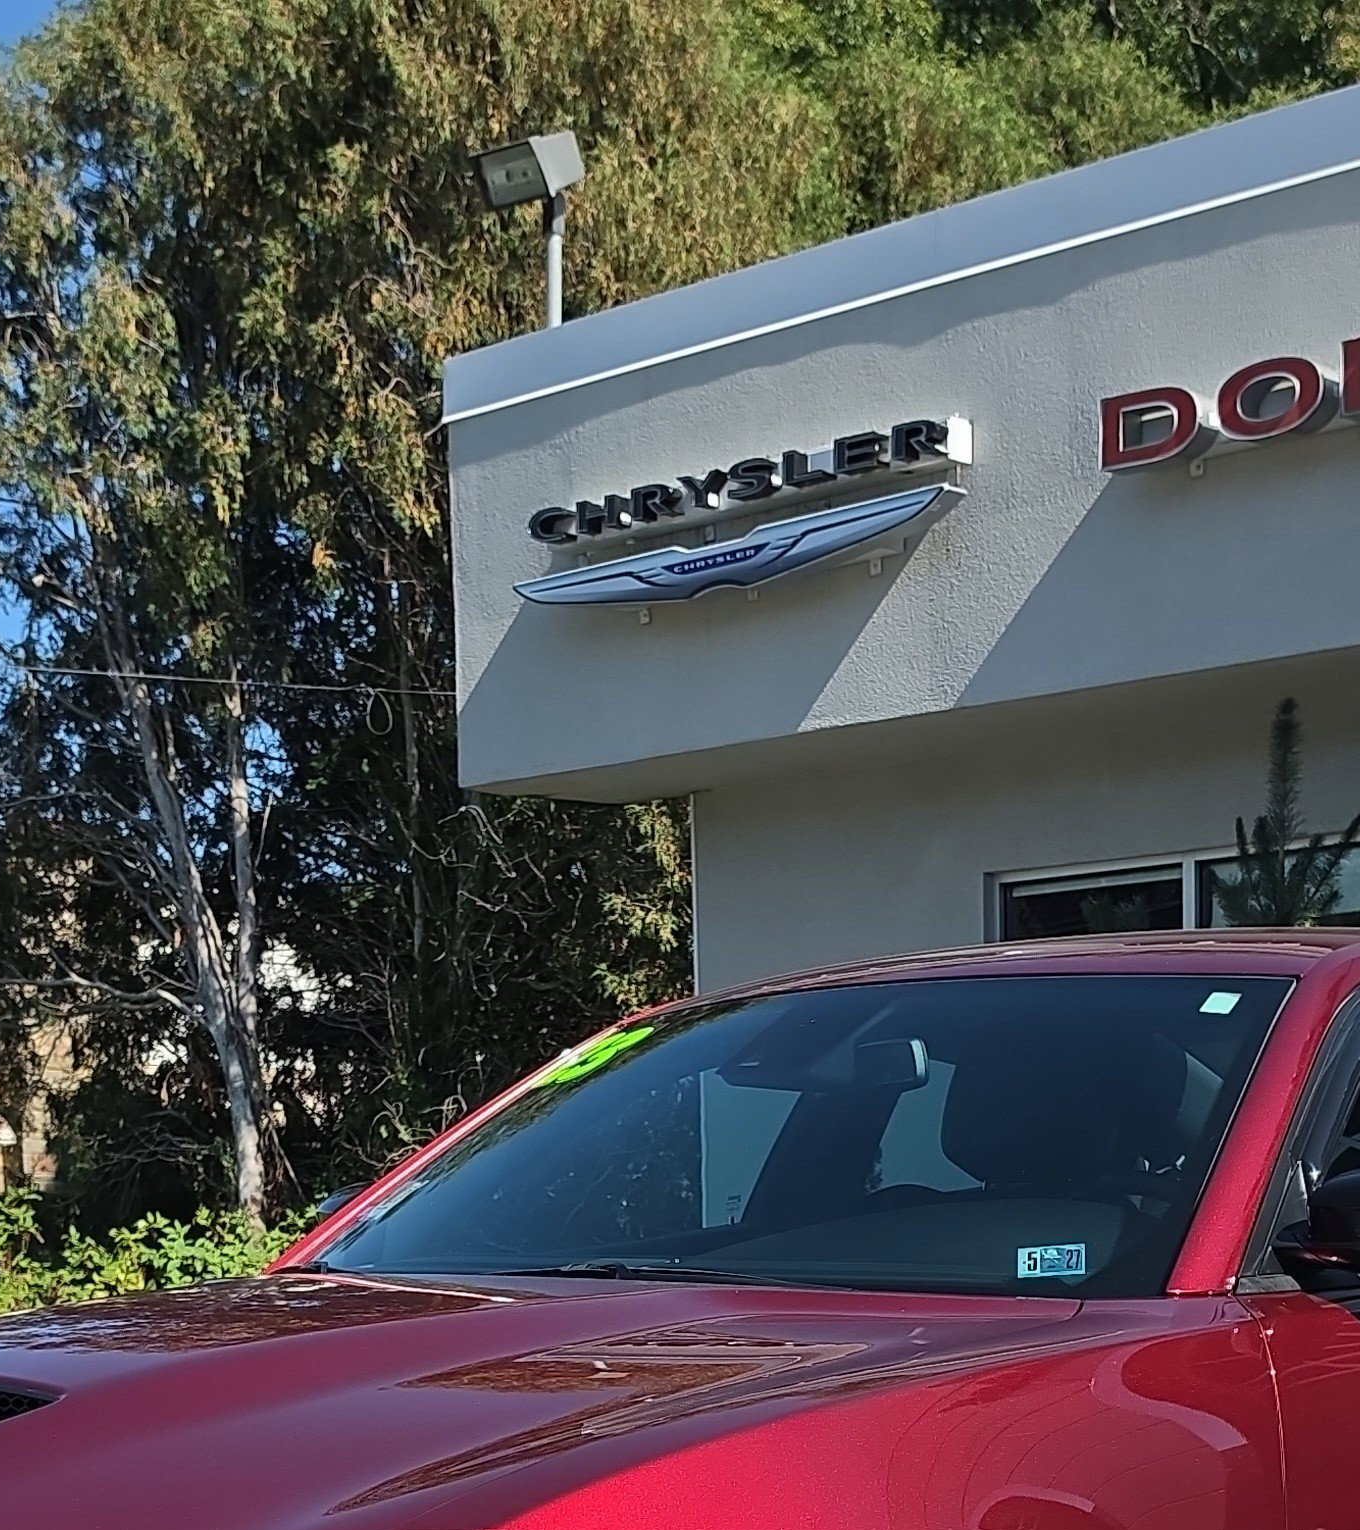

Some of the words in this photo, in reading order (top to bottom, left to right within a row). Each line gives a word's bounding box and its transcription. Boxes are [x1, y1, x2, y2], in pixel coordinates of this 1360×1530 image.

[527, 418, 949, 544] CHRYSLER
[673, 549, 756, 573] CHRYSLER
[1066, 1249, 1081, 1270] 27
